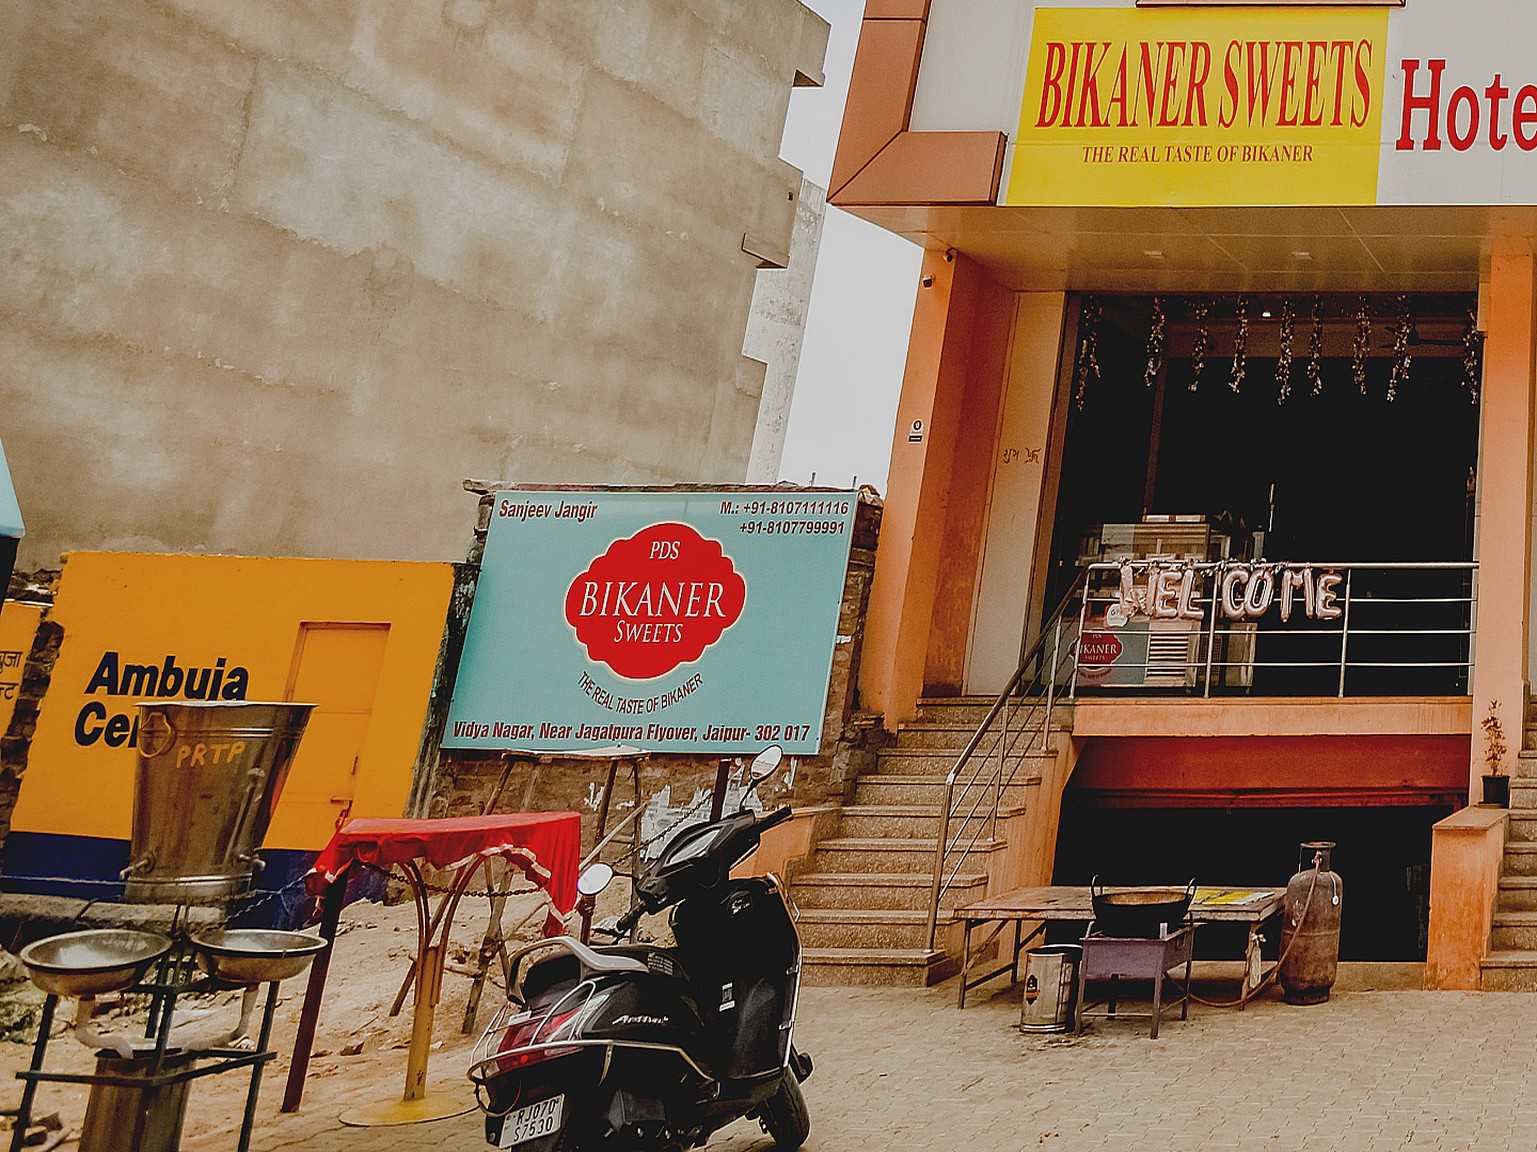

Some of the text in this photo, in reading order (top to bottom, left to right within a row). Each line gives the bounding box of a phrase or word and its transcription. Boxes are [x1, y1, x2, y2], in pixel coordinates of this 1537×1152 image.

[1034, 39, 1373, 129] BIKANER SWEETS
[1083, 144, 1313, 163] THE REAL TASTE OF BIKANER
[500, 500, 597, 522] Sanjeev Jangir
[743, 501, 848, 515] +91-8107111116
[740, 521, 844, 534] +91-8107799991
[649, 541, 680, 560] PDS
[579, 581, 726, 617] BIKANER
[614, 620, 683, 643] SWEETS
[1074, 643, 1117, 654] IKANER
[578, 671, 703, 714] THE REAL TASTE OF BIKANER
[453, 721, 489, 739] Vidya
[492, 722, 534, 740] Nagar,
[539, 723, 572, 738] Near
[575, 723, 643, 741] Jagatpura
[647, 724, 698, 742] Flyover,
[755, 725, 780, 741] 302
[784, 725, 810, 741] 017
